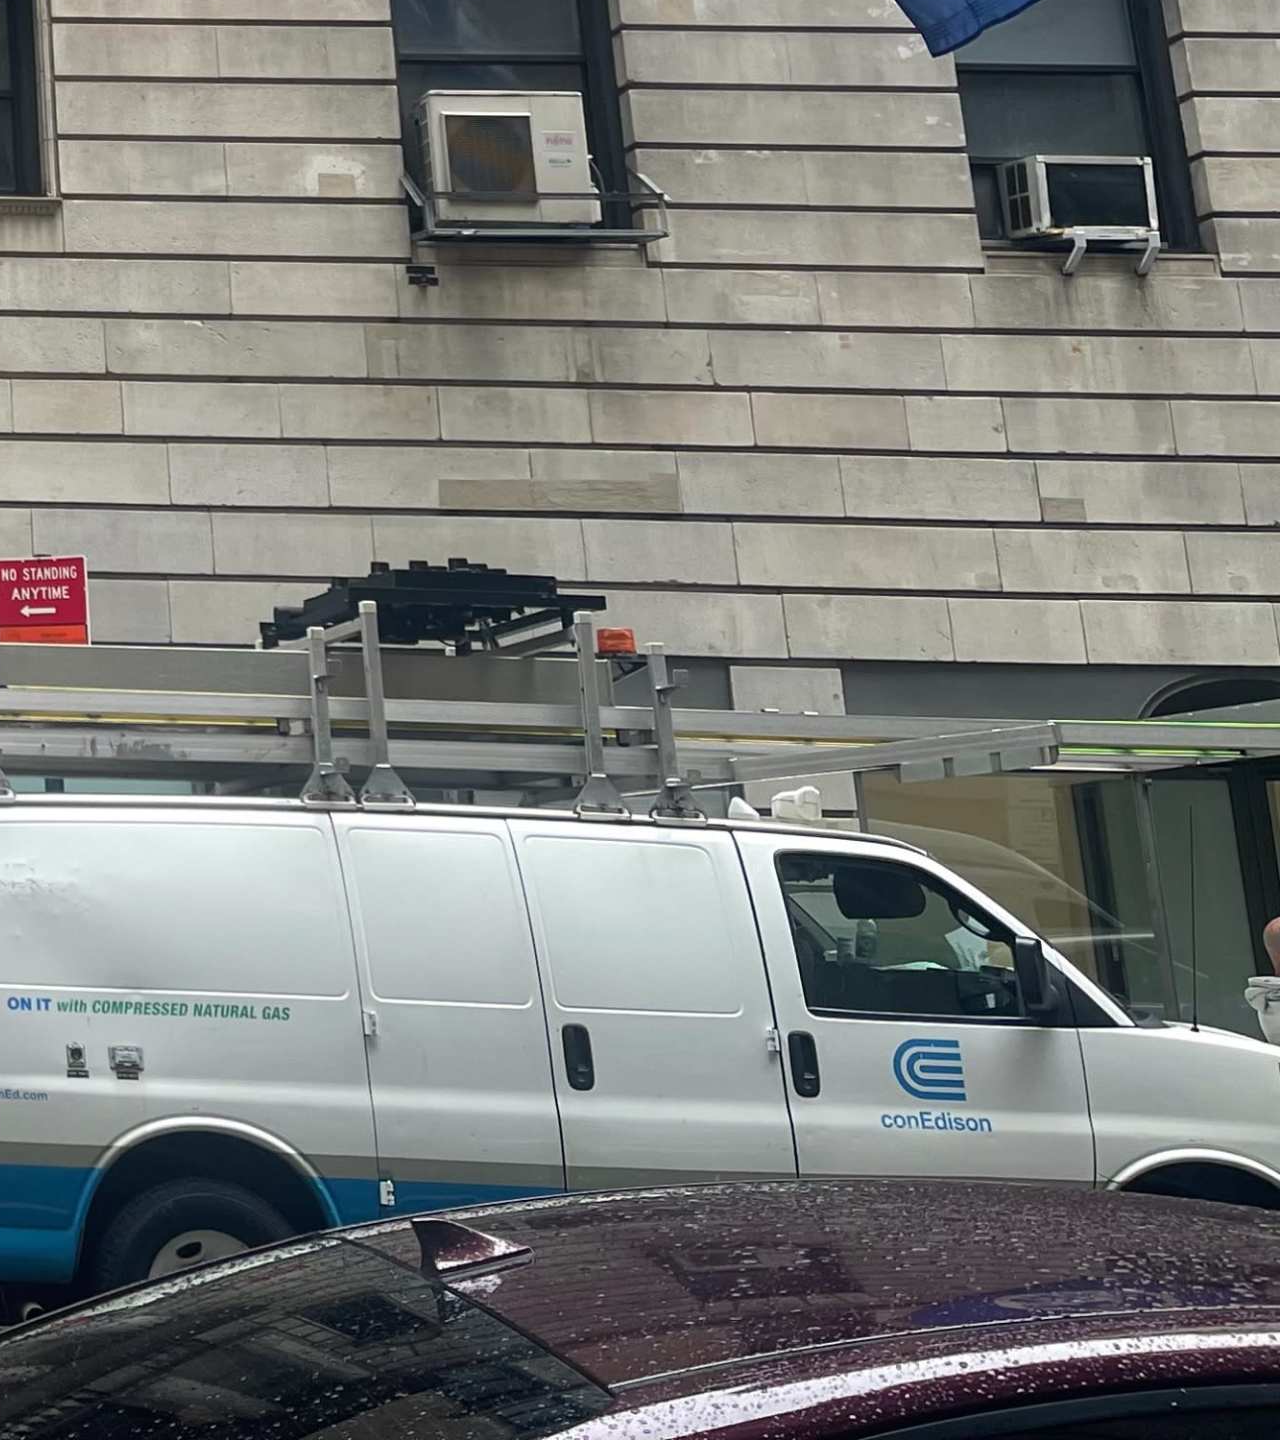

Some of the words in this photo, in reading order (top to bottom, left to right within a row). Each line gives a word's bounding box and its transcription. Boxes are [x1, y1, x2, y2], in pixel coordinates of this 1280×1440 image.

[1, 568, 17, 581] NO
[22, 566, 77, 581] STANDING
[11, 586, 70, 600] ANYTIME
[7, 997, 32, 1011] ON
[36, 998, 52, 1011] IT
[56, 999, 87, 1013] with
[92, 1000, 188, 1017] COMPRESSED
[193, 1003, 256, 1019] NATURAL
[262, 1006, 290, 1021] GAS
[881, 1111, 992, 1132] conEdison
